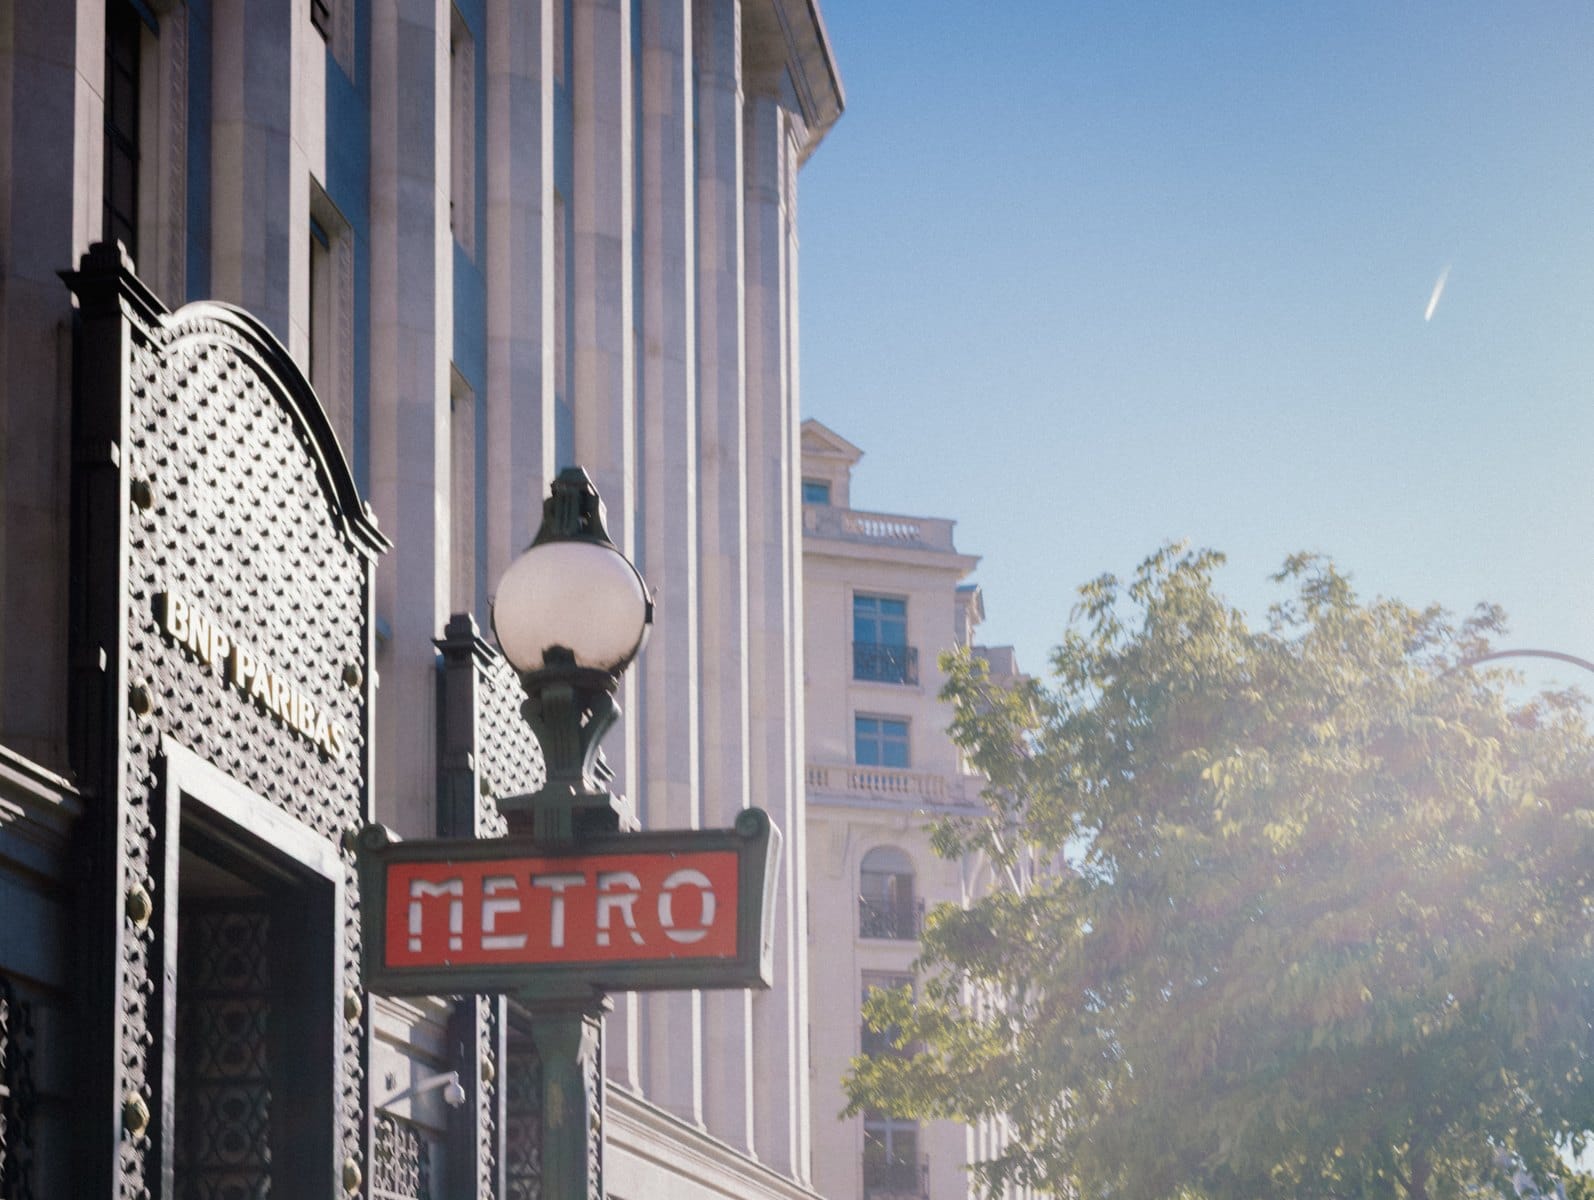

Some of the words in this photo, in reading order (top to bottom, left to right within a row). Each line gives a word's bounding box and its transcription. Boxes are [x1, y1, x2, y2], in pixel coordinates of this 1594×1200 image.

[166, 591, 231, 671] BNP
[235, 643, 347, 763] PARIBAS
[406, 867, 717, 953] METRO
